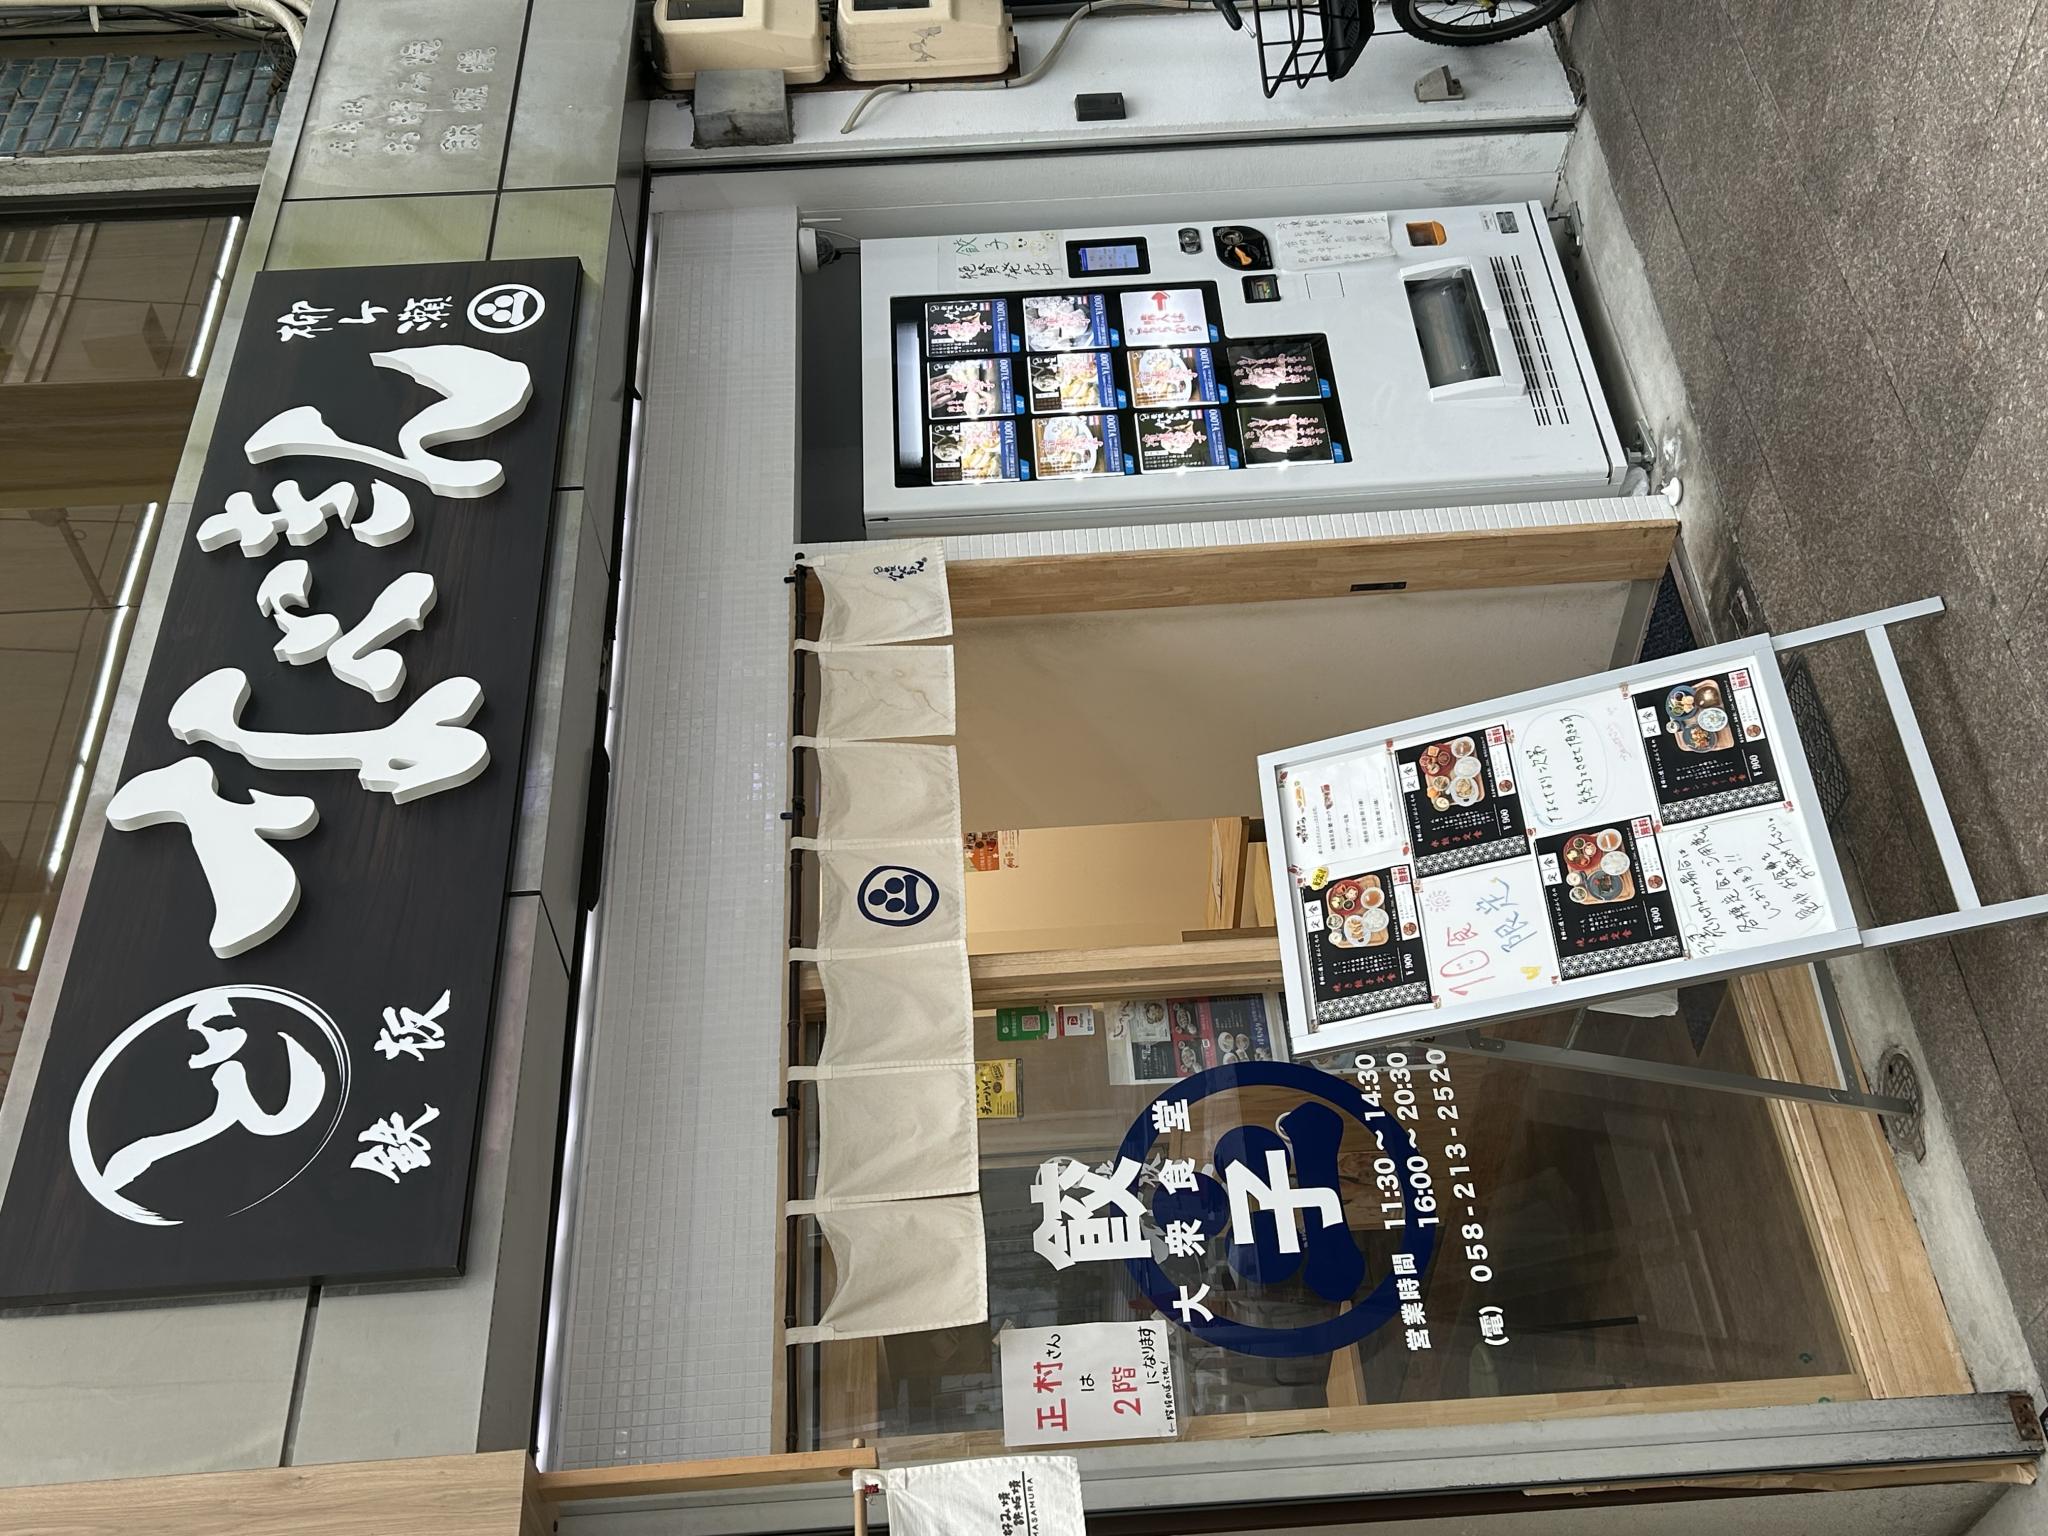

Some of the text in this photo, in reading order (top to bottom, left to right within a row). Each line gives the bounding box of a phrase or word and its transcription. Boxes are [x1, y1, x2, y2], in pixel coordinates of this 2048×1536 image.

[953, 236, 1009, 257] 餃子
[957, 262, 1063, 280] 絶賛発売中
[1737, 671, 1749, 688] 無料
[1492, 728, 1503, 744] 無料
[1642, 710, 1657, 734] 定食
[1402, 765, 1416, 789] 定食
[1638, 818, 1650, 836] 無料
[1398, 866, 1409, 883] 無料
[1544, 856, 1558, 883] 定食
[1306, 904, 1321, 929] 定食
[1475, 879, 1538, 953] 限定
[1438, 920, 1495, 997] 10食
[99, 995, 326, 1193] ど
[350, 988, 452, 1183] 鉄板
[980, 1079, 992, 1115] チューハイ
[1150, 1097, 1214, 1323] 大衆食堂
[1391, 1253, 1432, 1351] 営業時間
[1137, 1326, 1159, 1385] になります
[1033, 1333, 1068, 1432] 正村さん
[1079, 1373, 1095, 1392] は
[1112, 1366, 1142, 1416] 2階
[1009, 1480, 1024, 1526] 鉄板焼
